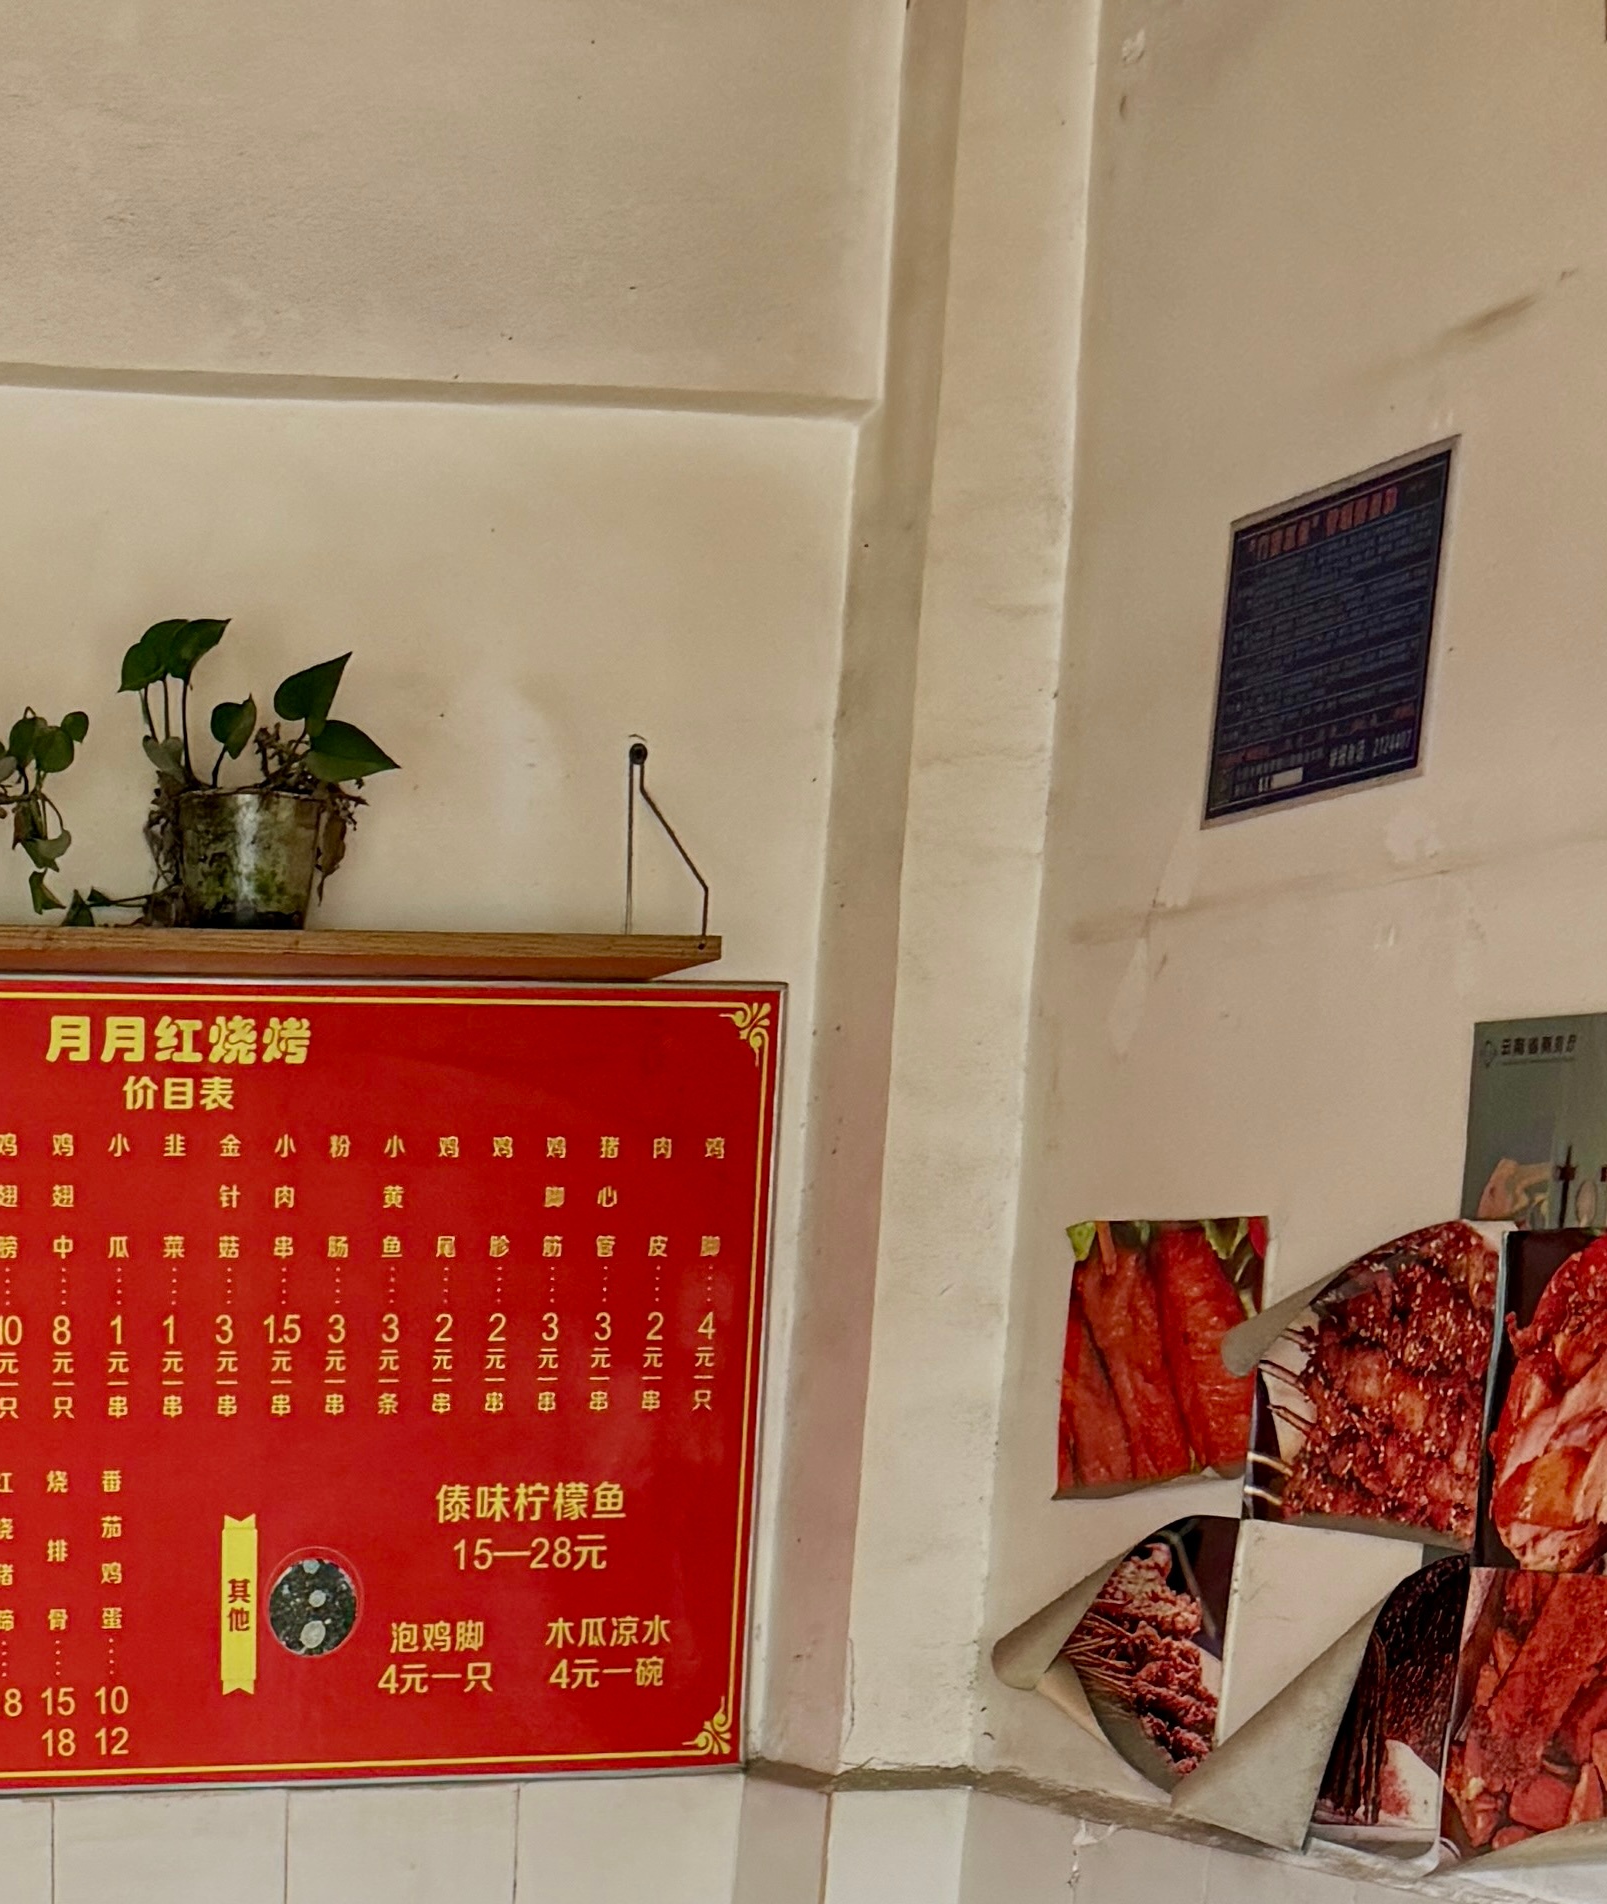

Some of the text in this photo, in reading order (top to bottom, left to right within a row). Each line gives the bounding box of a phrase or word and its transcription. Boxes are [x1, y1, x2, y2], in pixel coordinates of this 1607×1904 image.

[45, 1014, 312, 1065] 月月红烧烤
[122, 1075, 235, 1111] 价目表
[51, 1132, 74, 1260] 鸡翅中
[108, 1133, 131, 1259] 小瓜
[163, 1133, 186, 1259] 韭菜
[218, 1133, 242, 1259] 金针菇
[273, 1133, 296, 1259] 小肉串
[327, 1134, 351, 1258] 粉肠
[381, 1134, 405, 1258] 小黄鱼
[435, 1135, 460, 1258] 鸡尾
[596, 1136, 620, 1258] 猪心管
[647, 1136, 672, 1257] 肉皮
[435, 1480, 626, 1524] 傣味柠檬鱼
[40, 1470, 76, 1757] 烧排骨 15 18
[94, 1469, 129, 1756] 番茄鸡蛋 10 12
[227, 1578, 251, 1633] 其他
[389, 1619, 484, 1654] 泡鸡脚
[545, 1614, 671, 1649] 木瓜凉水
[377, 1662, 493, 1695] 4元一只
[549, 1656, 664, 1689] 4元一碗
